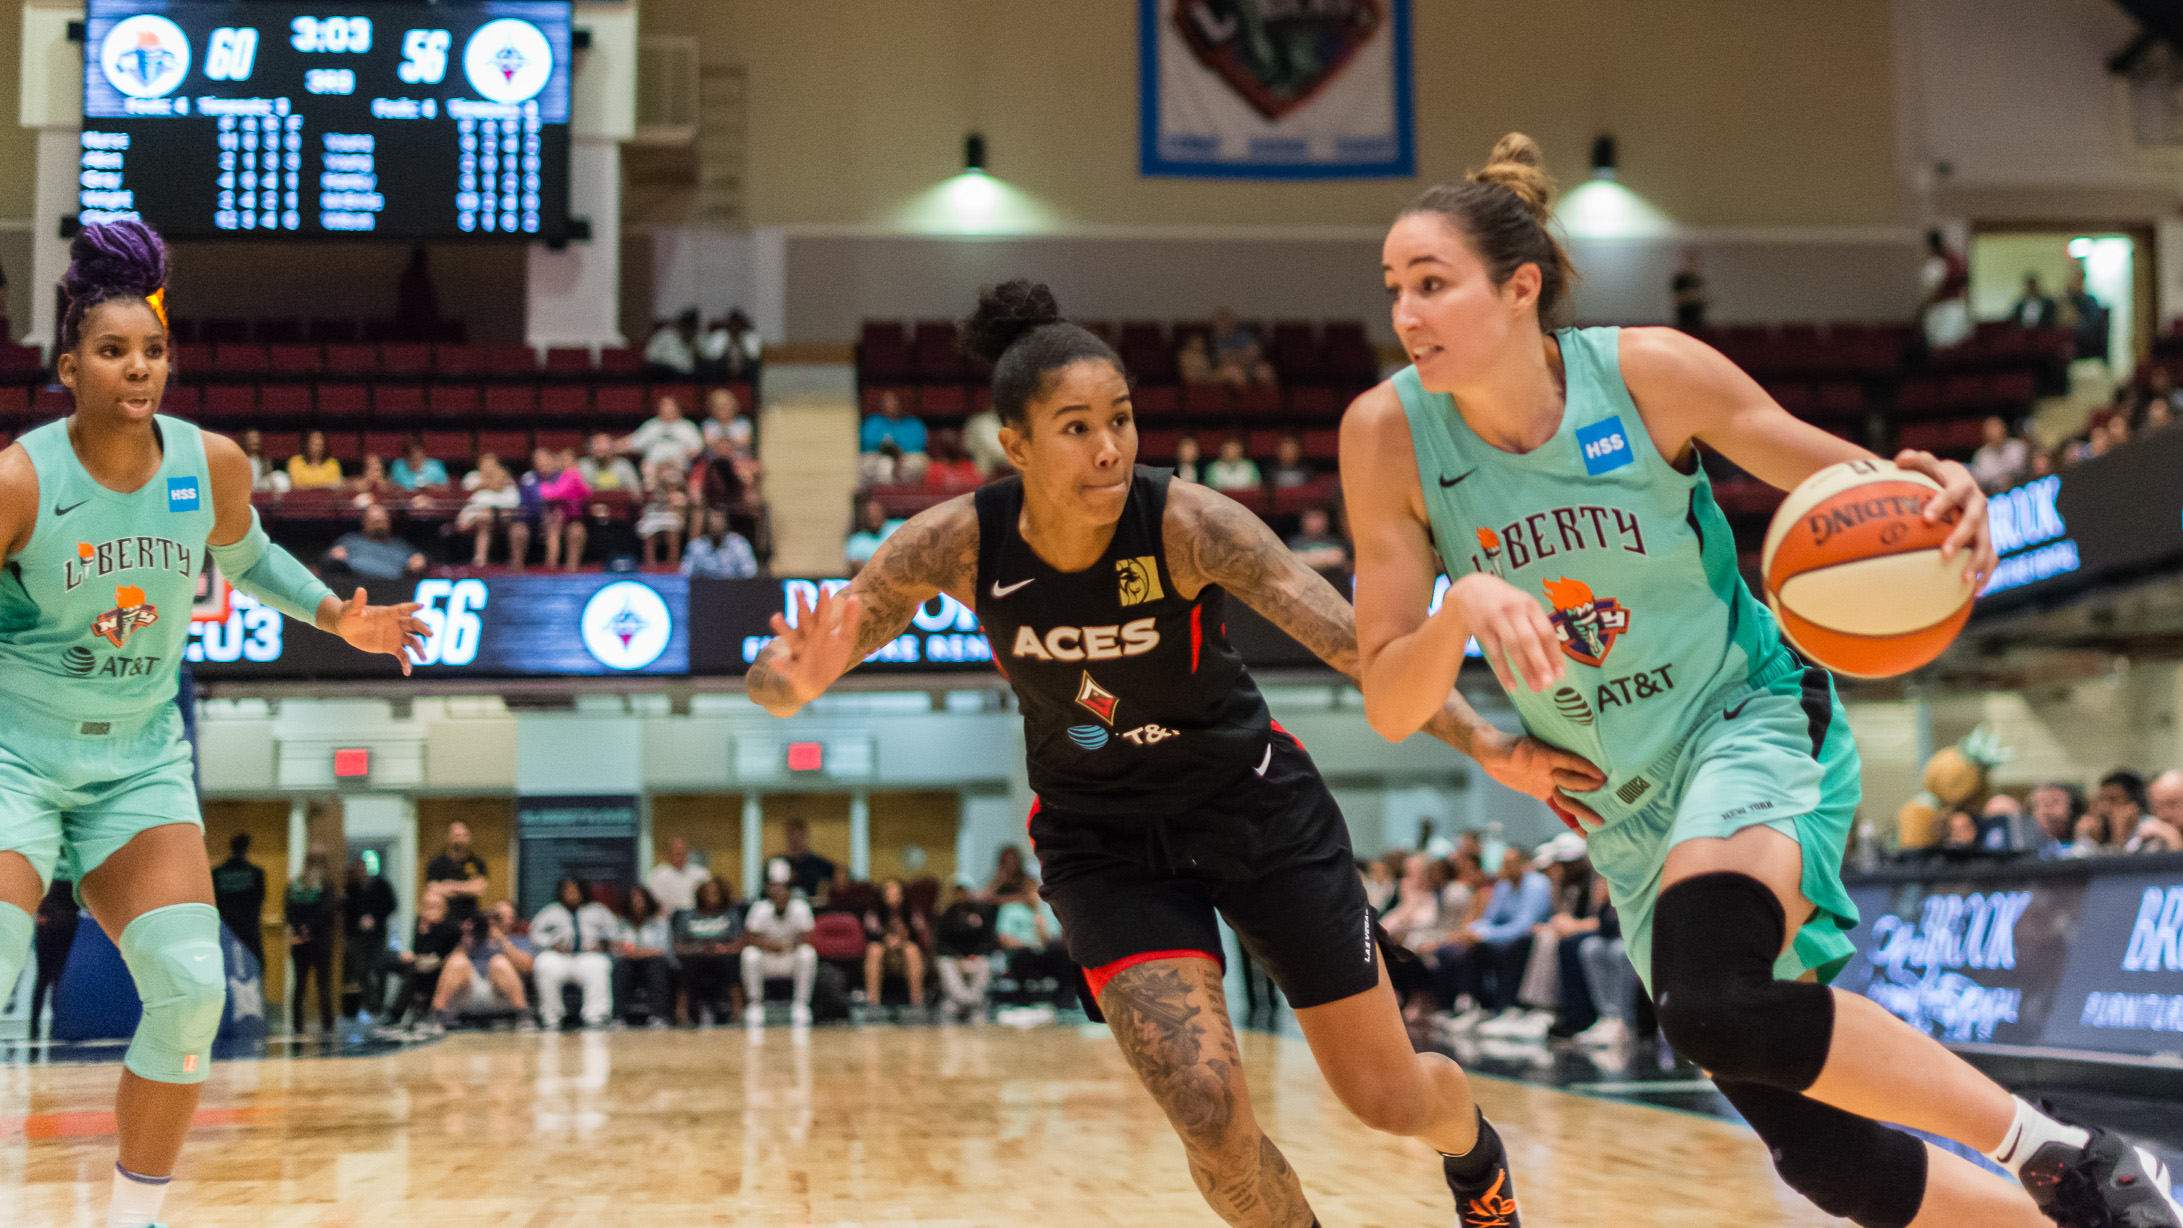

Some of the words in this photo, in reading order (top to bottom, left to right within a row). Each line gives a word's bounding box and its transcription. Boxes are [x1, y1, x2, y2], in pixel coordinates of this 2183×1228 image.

[203, 27, 259, 81] 60
[290, 16, 373, 53] 3:03
[399, 29, 452, 84] 56
[1585, 432, 1625, 459] HSS
[171, 487, 196, 502] HSS
[63, 536, 192, 593] LIBERTY
[411, 578, 490, 666] 56
[1012, 617, 1161, 662] ACES
[99, 655, 160, 678] AT&T
[1597, 663, 1675, 713] AT&T
[1721, 807, 1747, 821] NEW
[1749, 800, 1775, 813] YORK
